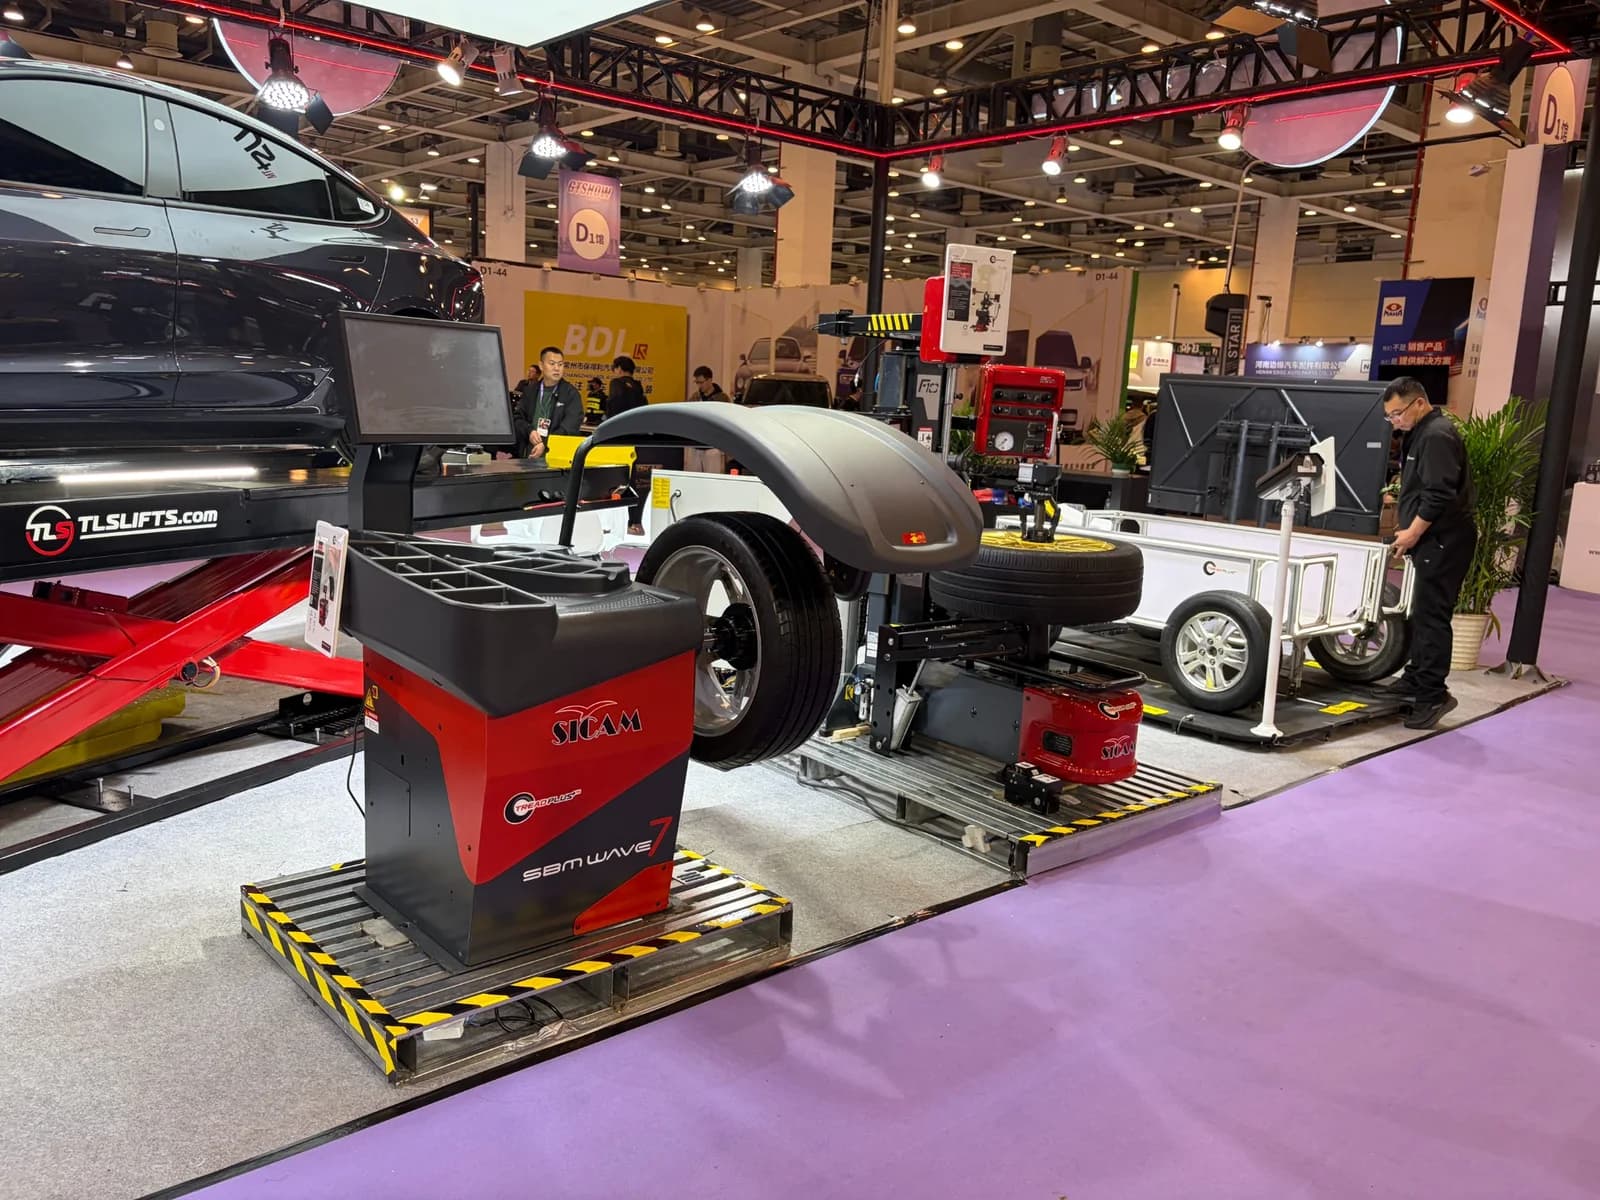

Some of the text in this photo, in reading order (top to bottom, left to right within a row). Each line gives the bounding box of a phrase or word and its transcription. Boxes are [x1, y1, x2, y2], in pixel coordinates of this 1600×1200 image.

[568, 180, 613, 196] GTSHOW
[575, 222, 605, 245] D1馆
[480, 265, 507, 277] D1-44
[1096, 272, 1118, 281] D1-44
[26, 520, 74, 542] TLS
[78, 509, 218, 533] TLSLIFTS.com
[552, 708, 643, 746] SICAM
[587, 840, 652, 865] WAVE
[649, 816, 673, 857] 7
